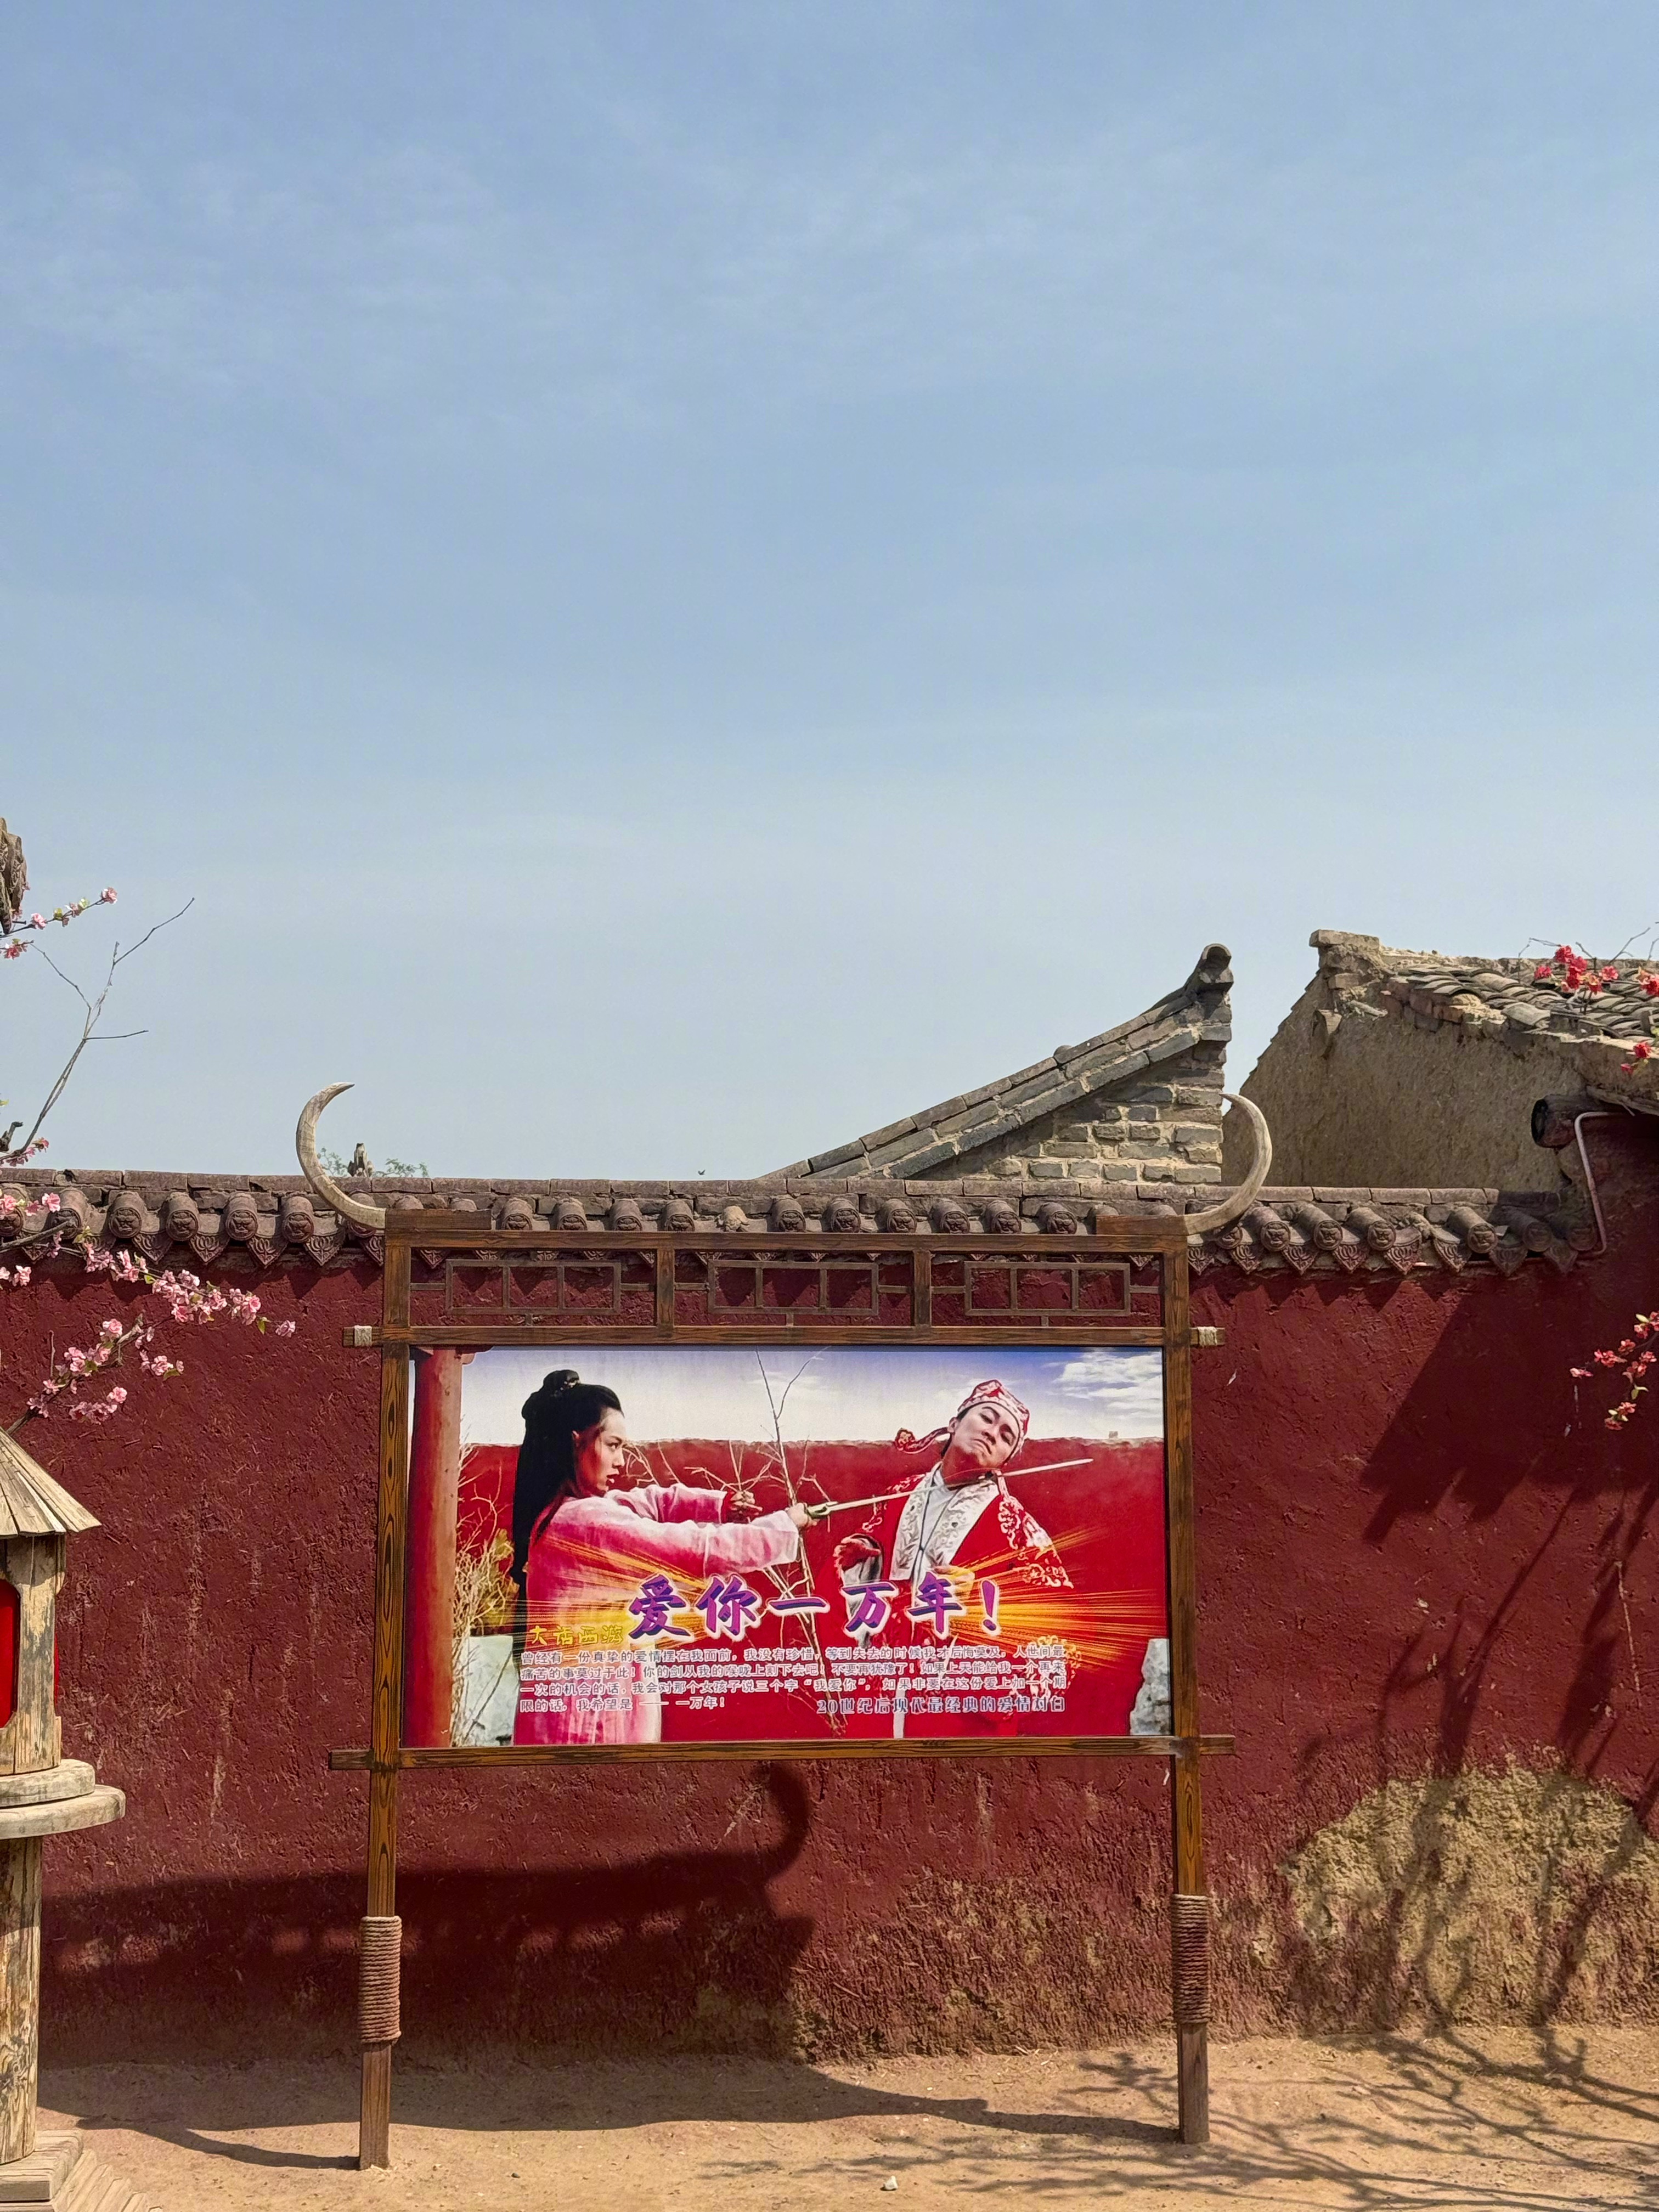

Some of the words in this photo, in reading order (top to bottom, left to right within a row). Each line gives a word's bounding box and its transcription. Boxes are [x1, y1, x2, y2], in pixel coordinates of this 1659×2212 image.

[628, 1571, 998, 1640] 爱你一万年！
[529, 1624, 624, 1644] 大话西游
[816, 1696, 1065, 1714] 20世纪后现代最经典的爱情对白
